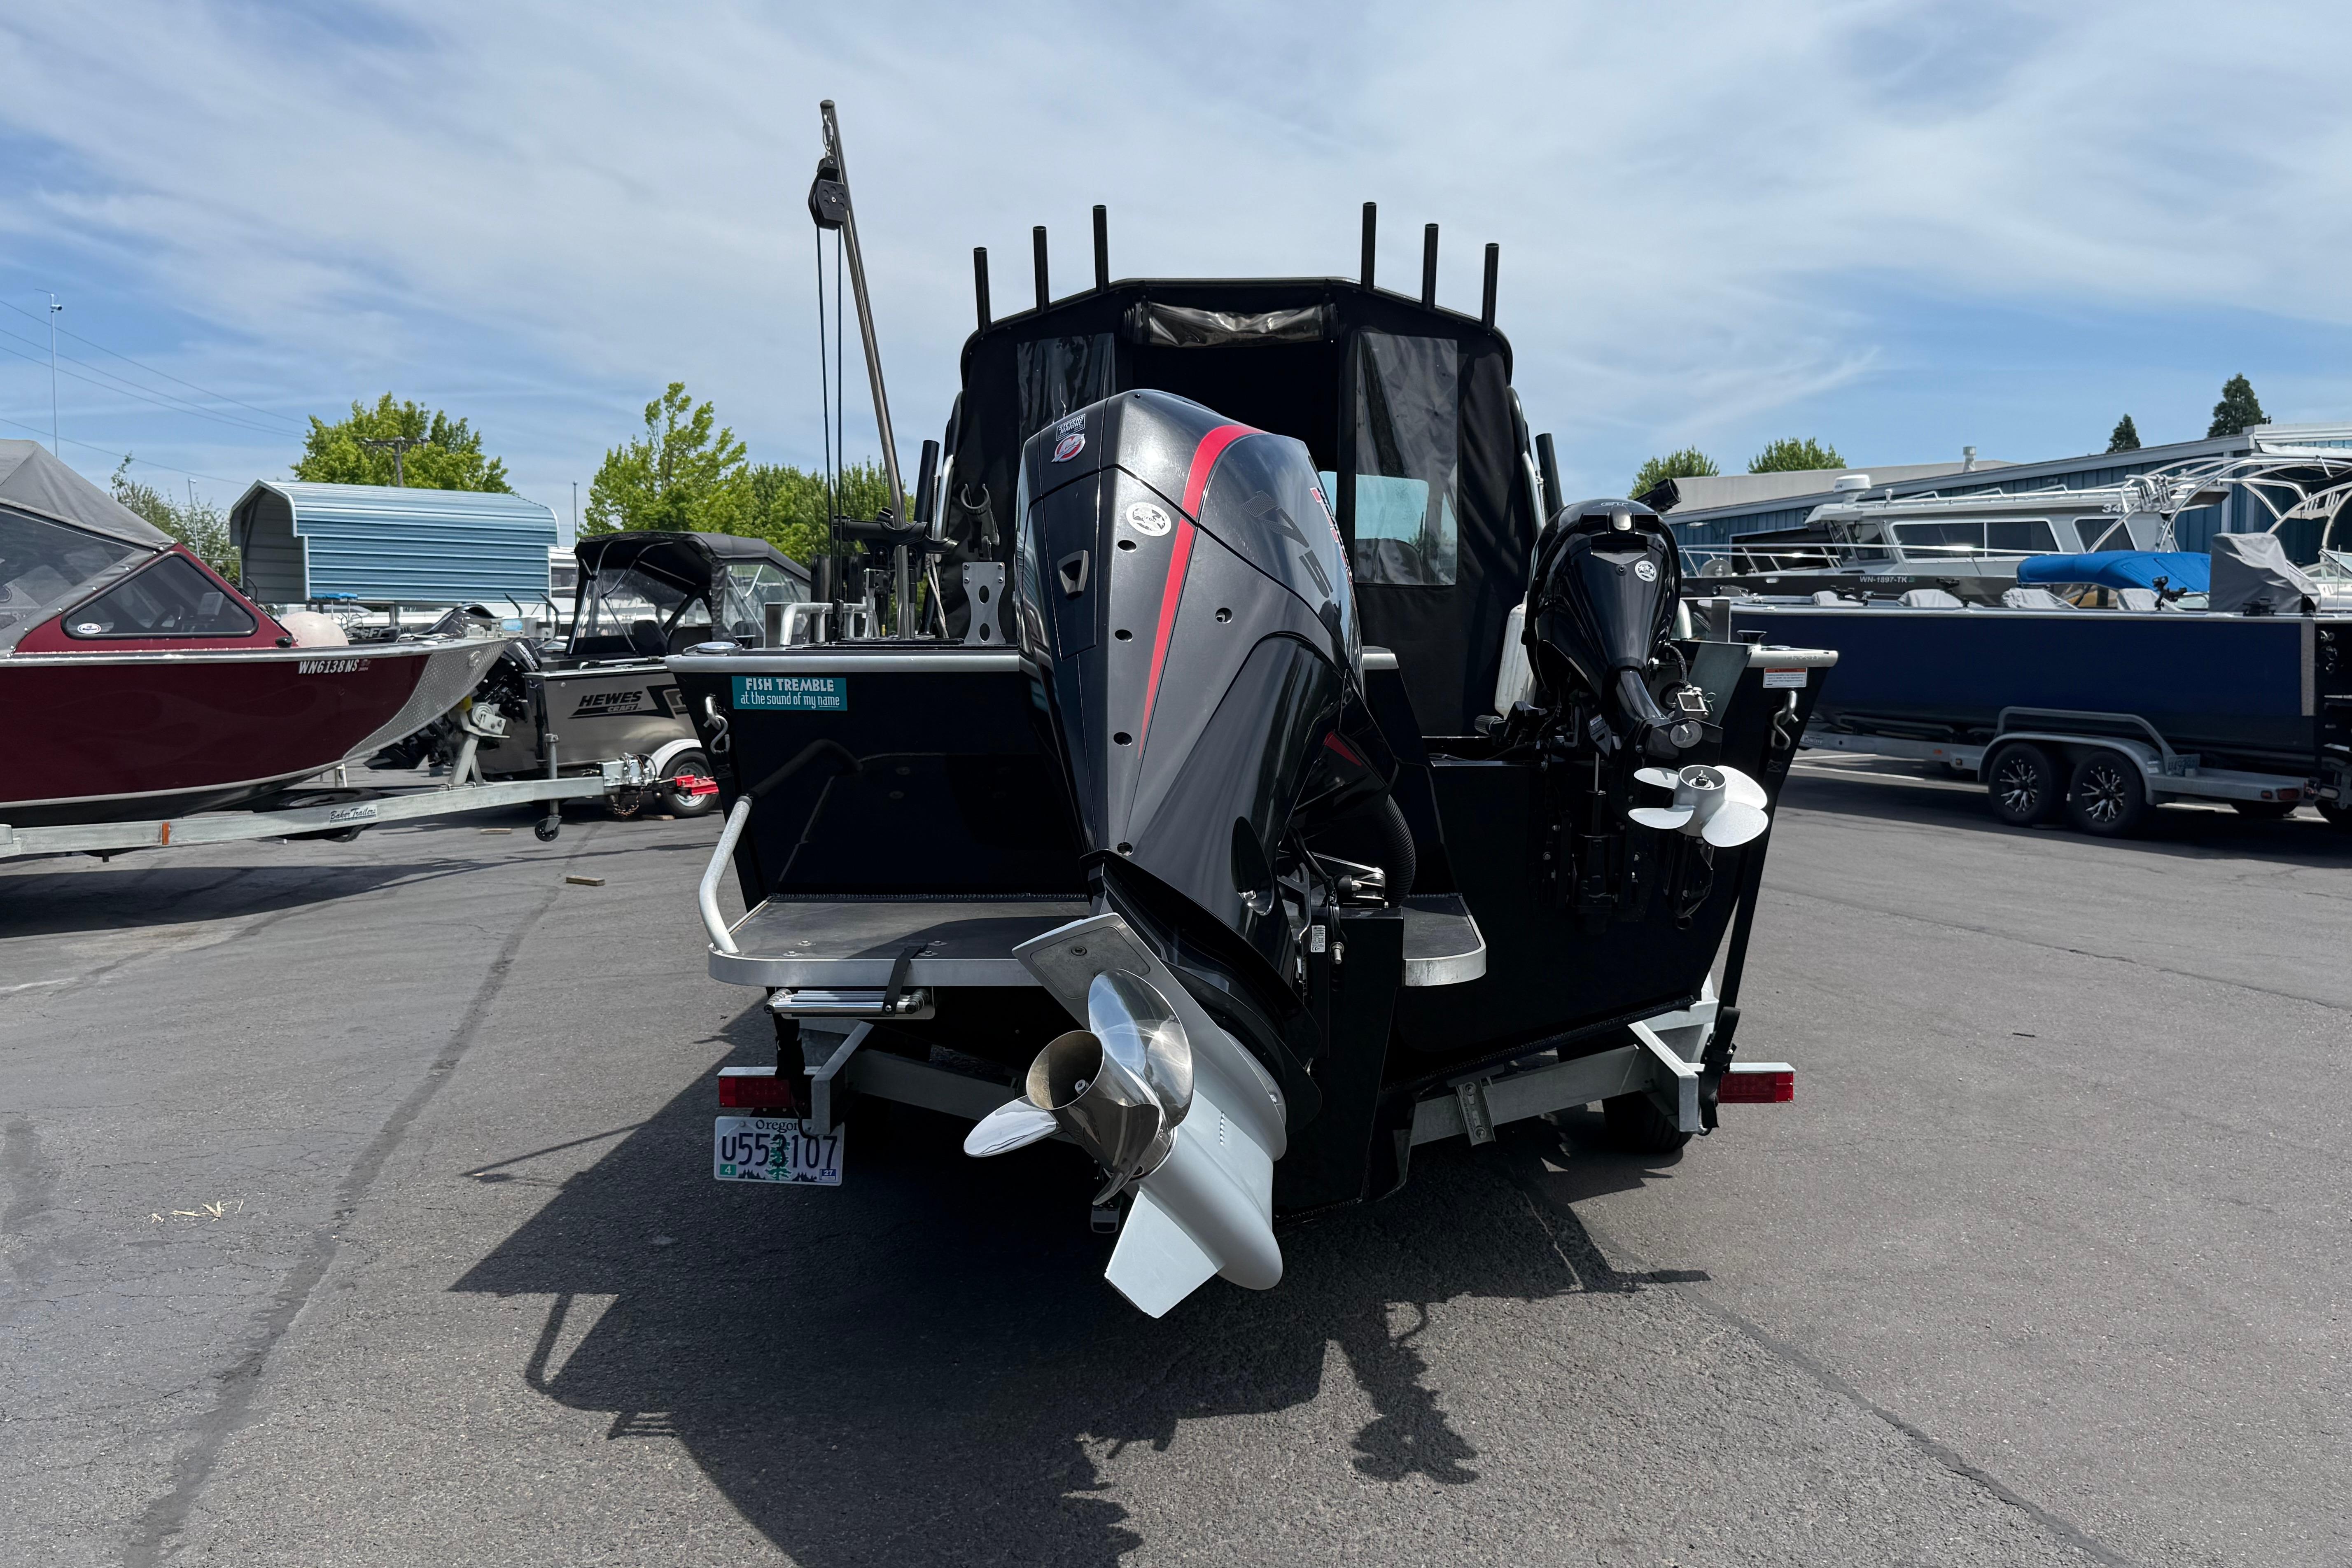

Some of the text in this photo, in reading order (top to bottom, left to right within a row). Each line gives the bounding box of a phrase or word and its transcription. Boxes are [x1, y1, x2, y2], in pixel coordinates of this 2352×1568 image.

[299, 659, 359, 674] WN6138NS
[746, 678, 834, 692] FISH TREMBLE
[579, 691, 643, 707] HEWES
[740, 691, 840, 709] at the sound of my name
[607, 704, 637, 712] CRAFT
[331, 810, 350, 819] Baker
[350, 807, 376, 817] Trailers
[722, 1132, 838, 1169] U553107
[725, 1165, 732, 1174] 4
